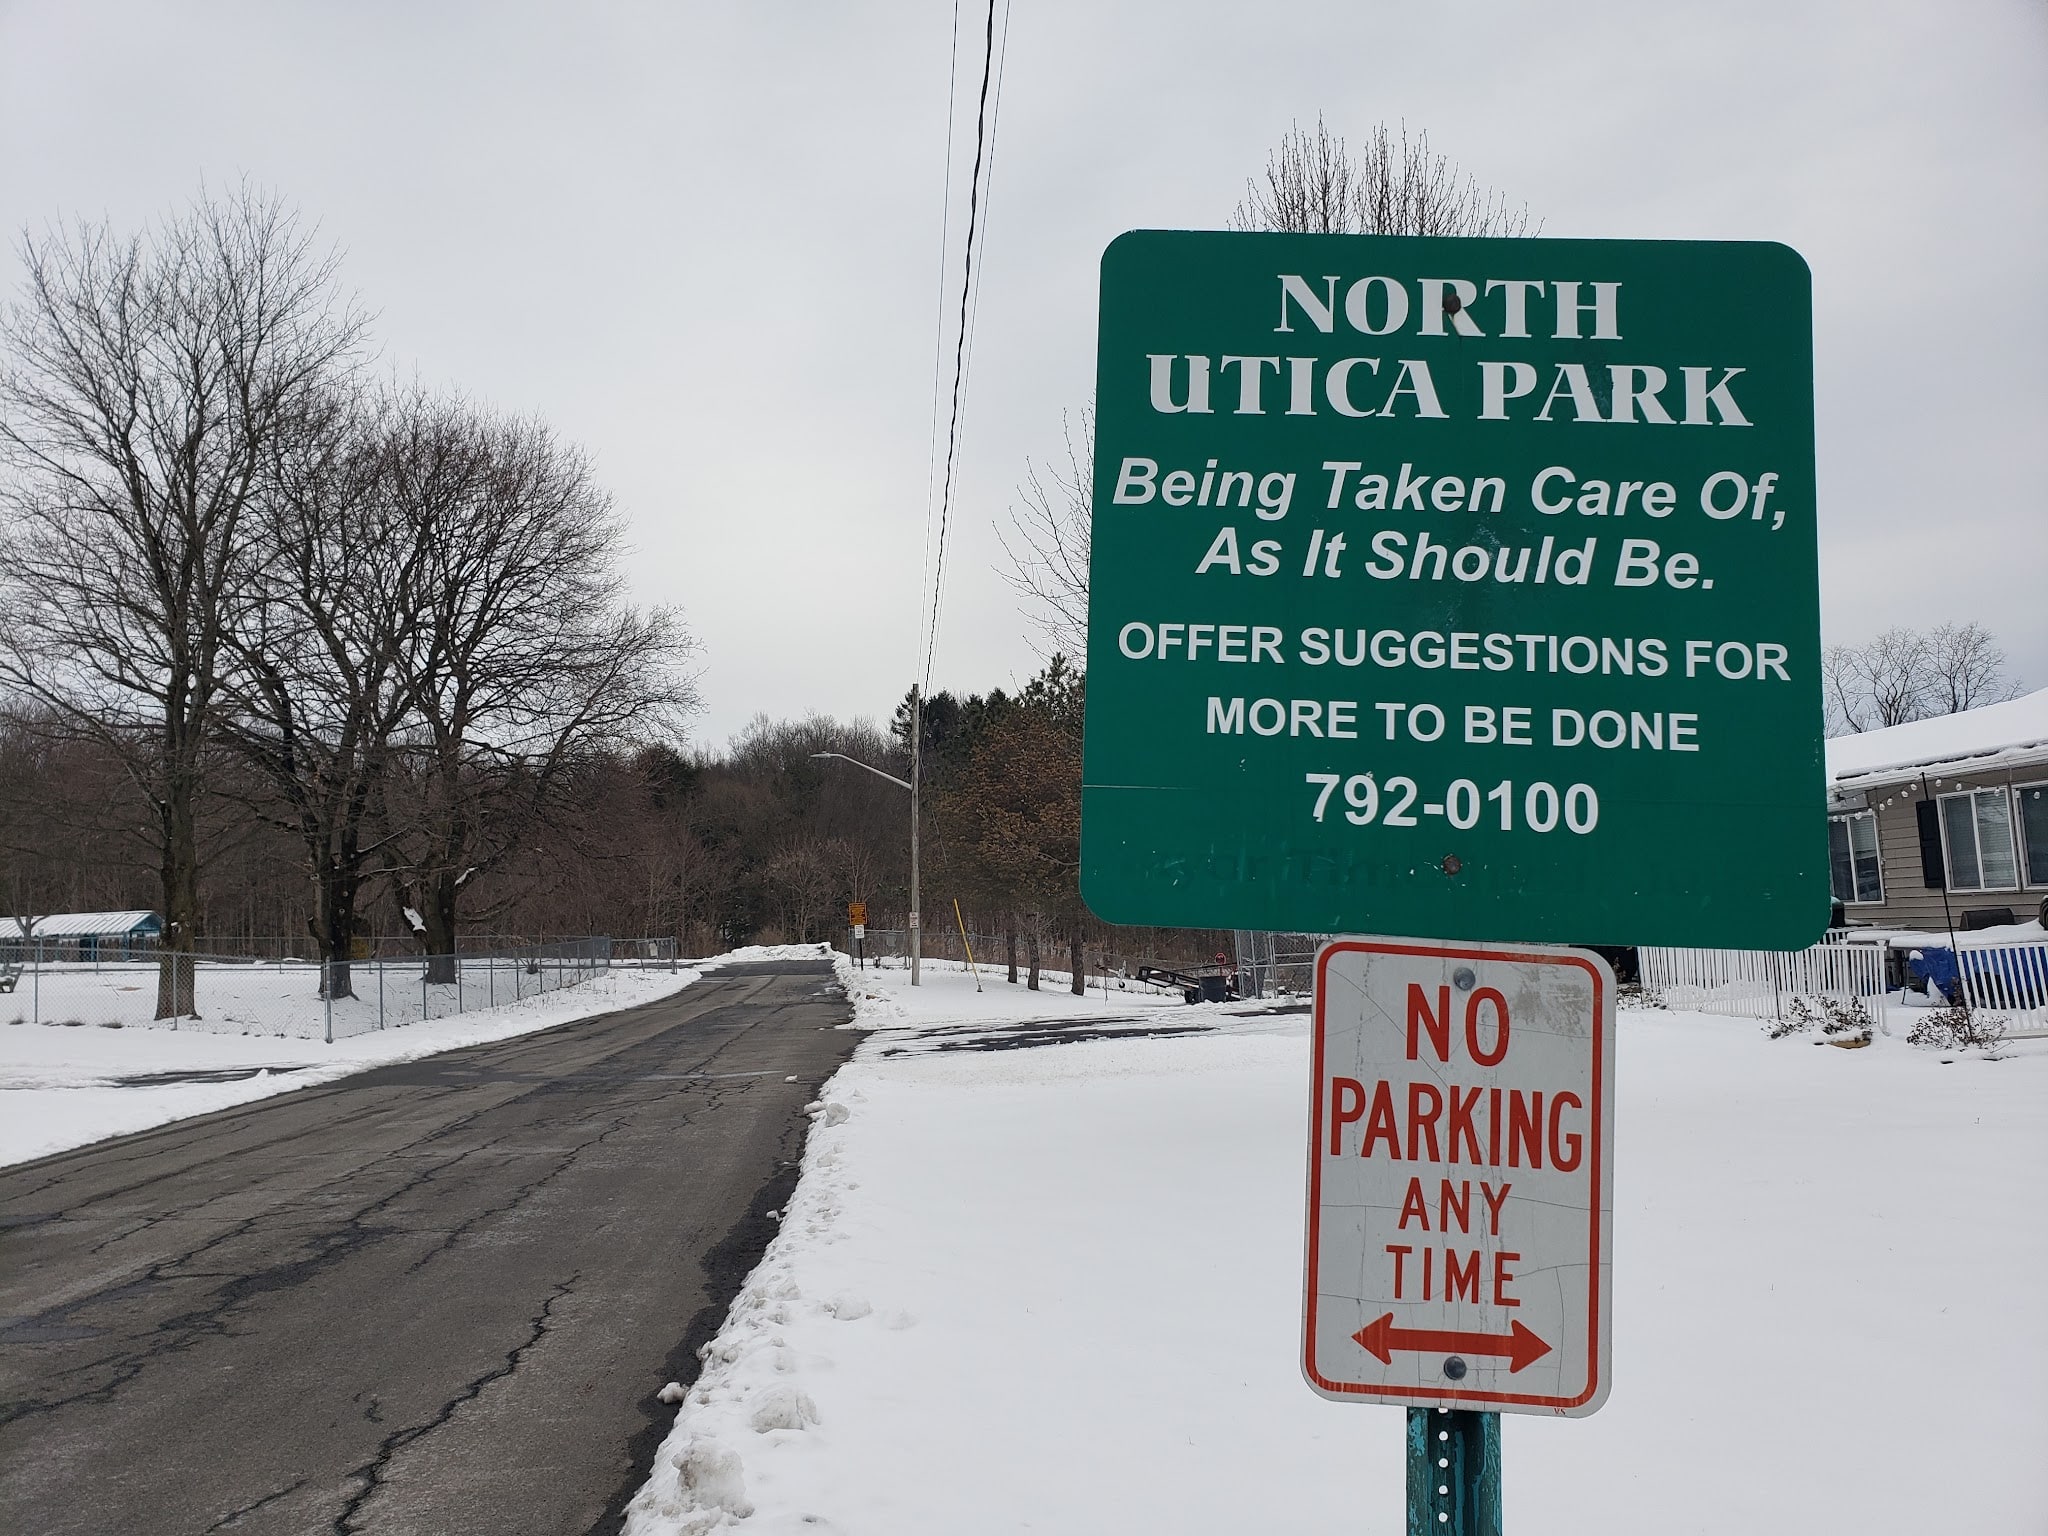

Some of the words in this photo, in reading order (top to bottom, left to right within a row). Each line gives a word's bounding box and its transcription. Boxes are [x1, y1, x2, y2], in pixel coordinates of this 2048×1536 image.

[1273, 274, 1623, 340] NORTH
[1145, 354, 1450, 419] UTICA
[1476, 361, 1754, 427] PARK
[1112, 457, 1297, 521] Being
[1322, 461, 1506, 513] Taken
[1531, 466, 1677, 518] Care
[1700, 471, 1786, 531] Of,
[1194, 526, 1283, 577] As
[1302, 529, 1347, 578] It
[1365, 530, 1597, 586] Should
[1613, 538, 1714, 590] Be.
[1118, 621, 1285, 664] OFFER
[1299, 627, 1669, 677] SUGGESTIONS
[1685, 640, 1792, 681] FOR
[1206, 696, 1358, 739] MORE
[1374, 702, 1446, 742] TO
[1464, 705, 1533, 746] BE
[1552, 708, 1700, 752] DONE
[1305, 771, 1599, 835] 792-0100
[1406, 983, 1510, 1067] NO
[1331, 1077, 1582, 1173] PARKING
[1399, 1177, 1510, 1235] ANY
[1386, 1245, 1521, 1307] TIME
